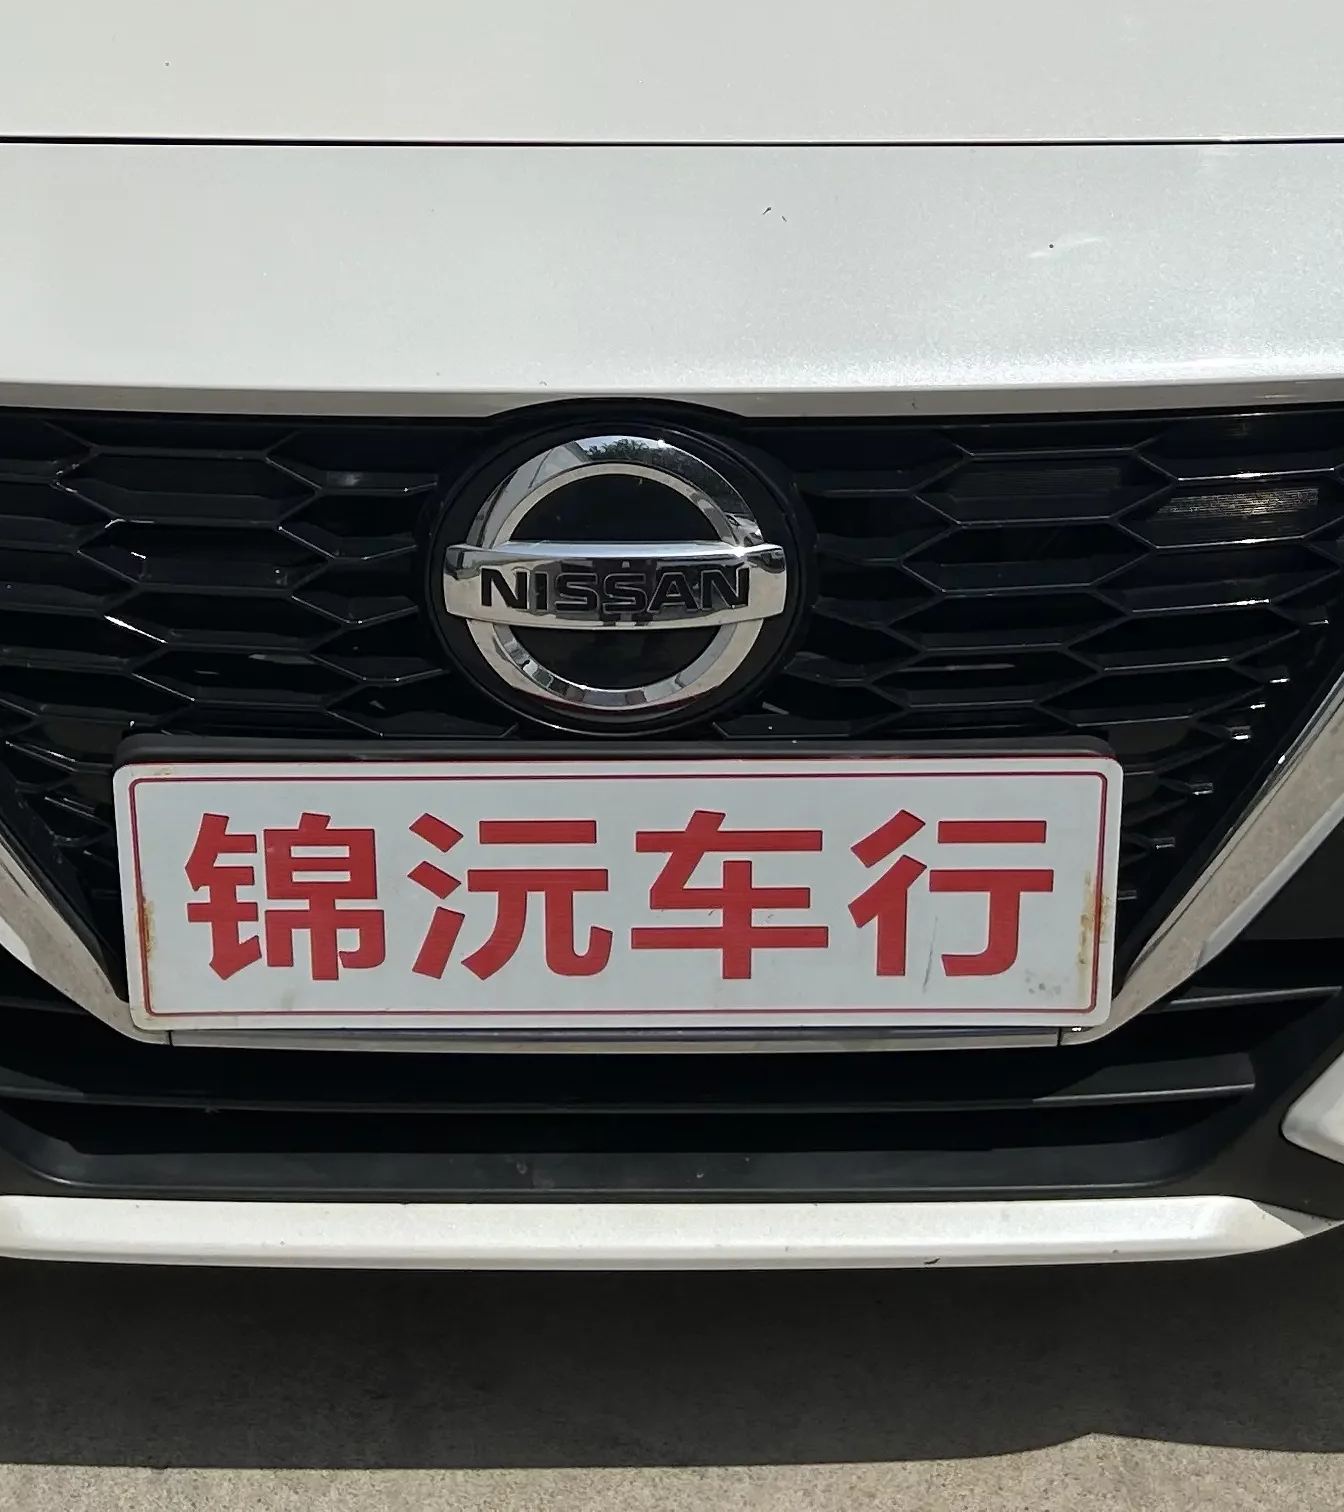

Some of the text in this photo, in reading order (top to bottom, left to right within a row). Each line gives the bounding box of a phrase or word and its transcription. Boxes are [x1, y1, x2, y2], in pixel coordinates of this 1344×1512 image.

[480, 565, 751, 613] NISSAN
[185, 810, 1054, 980] 锦沅车行
